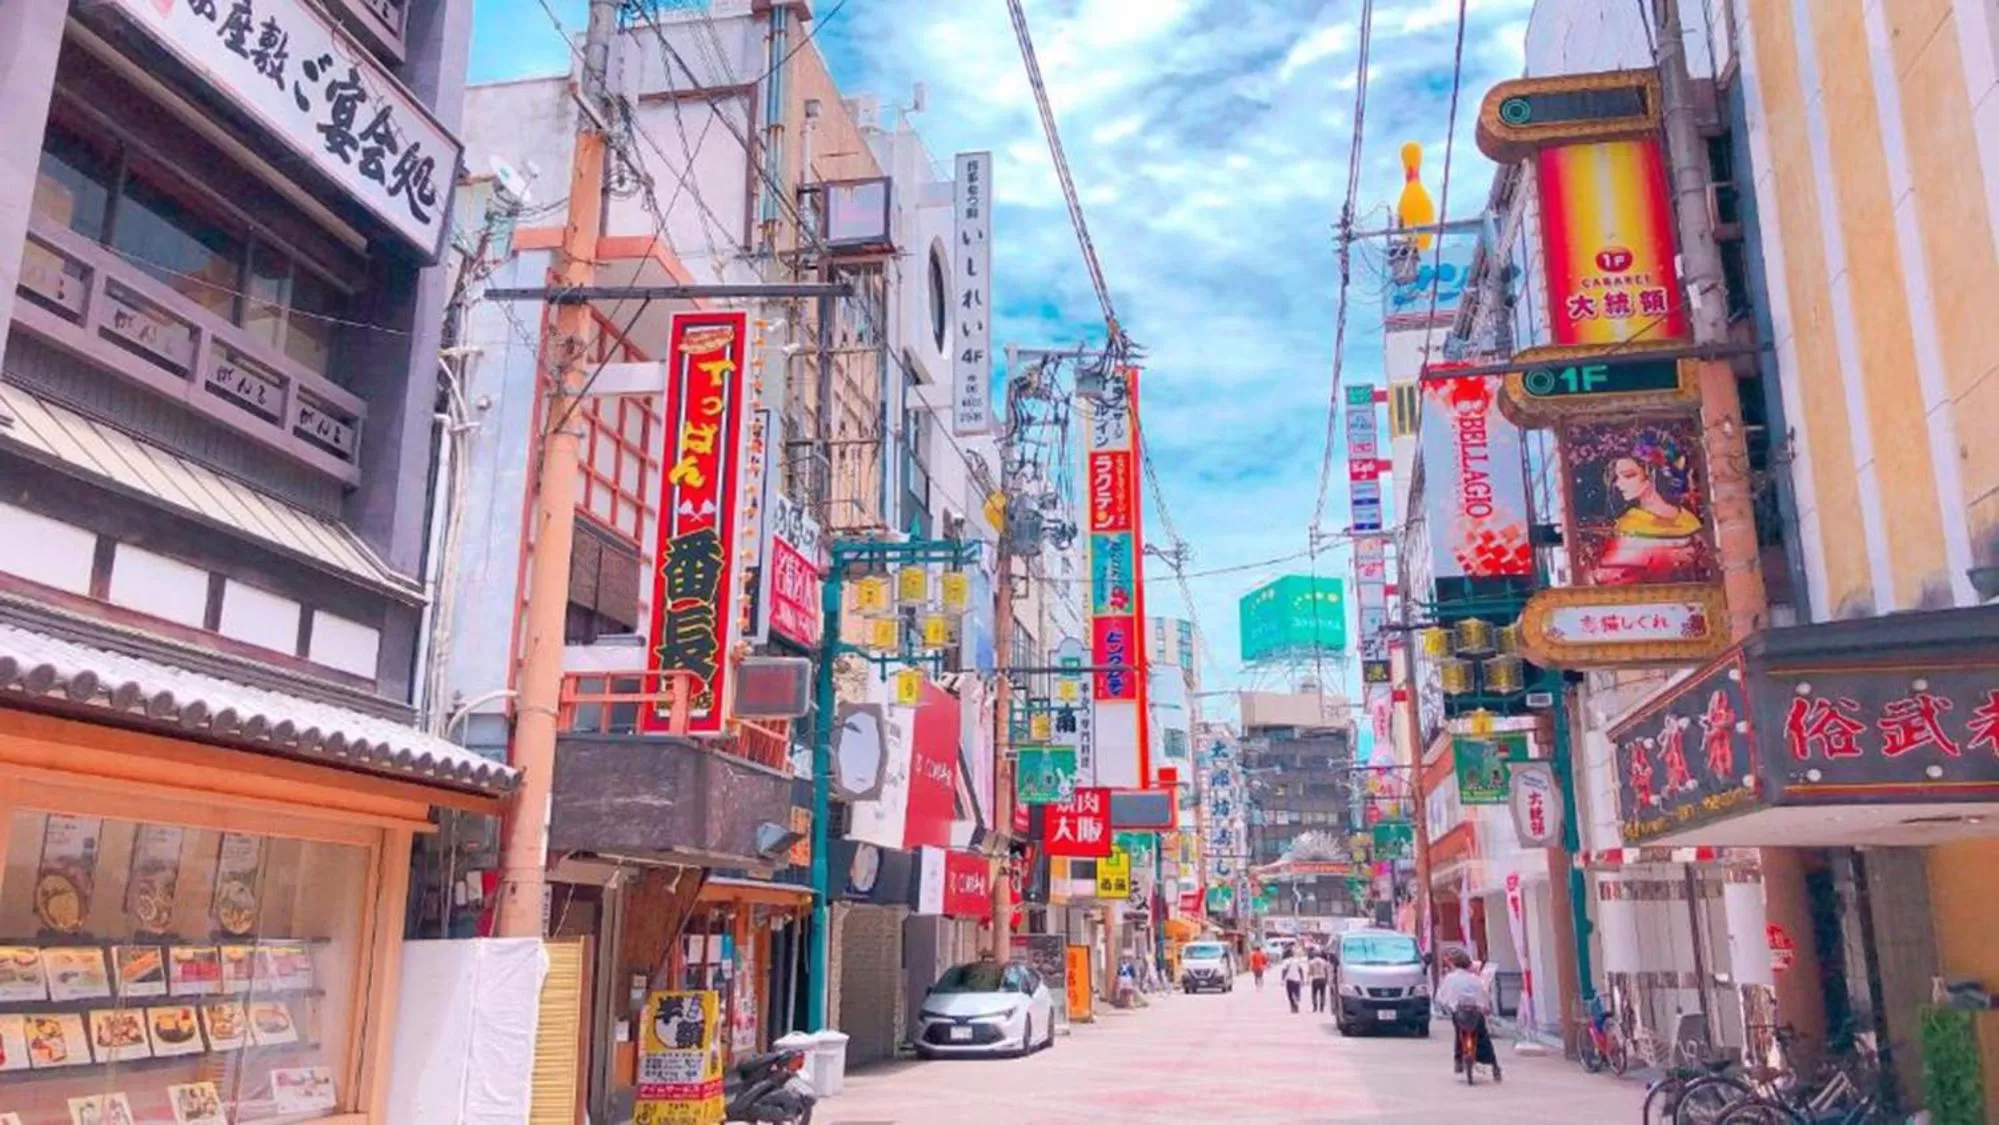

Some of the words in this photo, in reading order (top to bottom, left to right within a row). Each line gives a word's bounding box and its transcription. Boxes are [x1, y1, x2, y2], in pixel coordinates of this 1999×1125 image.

[1601, 253, 1626, 269] 1F
[1568, 289, 1669, 318] 大統領
[961, 349, 984, 364] 4F
[1558, 364, 1609, 392] 1F
[668, 357, 737, 488] てっぱん
[1459, 416, 1493, 519] BELLAGIO
[1094, 455, 1116, 529] ラクテン
